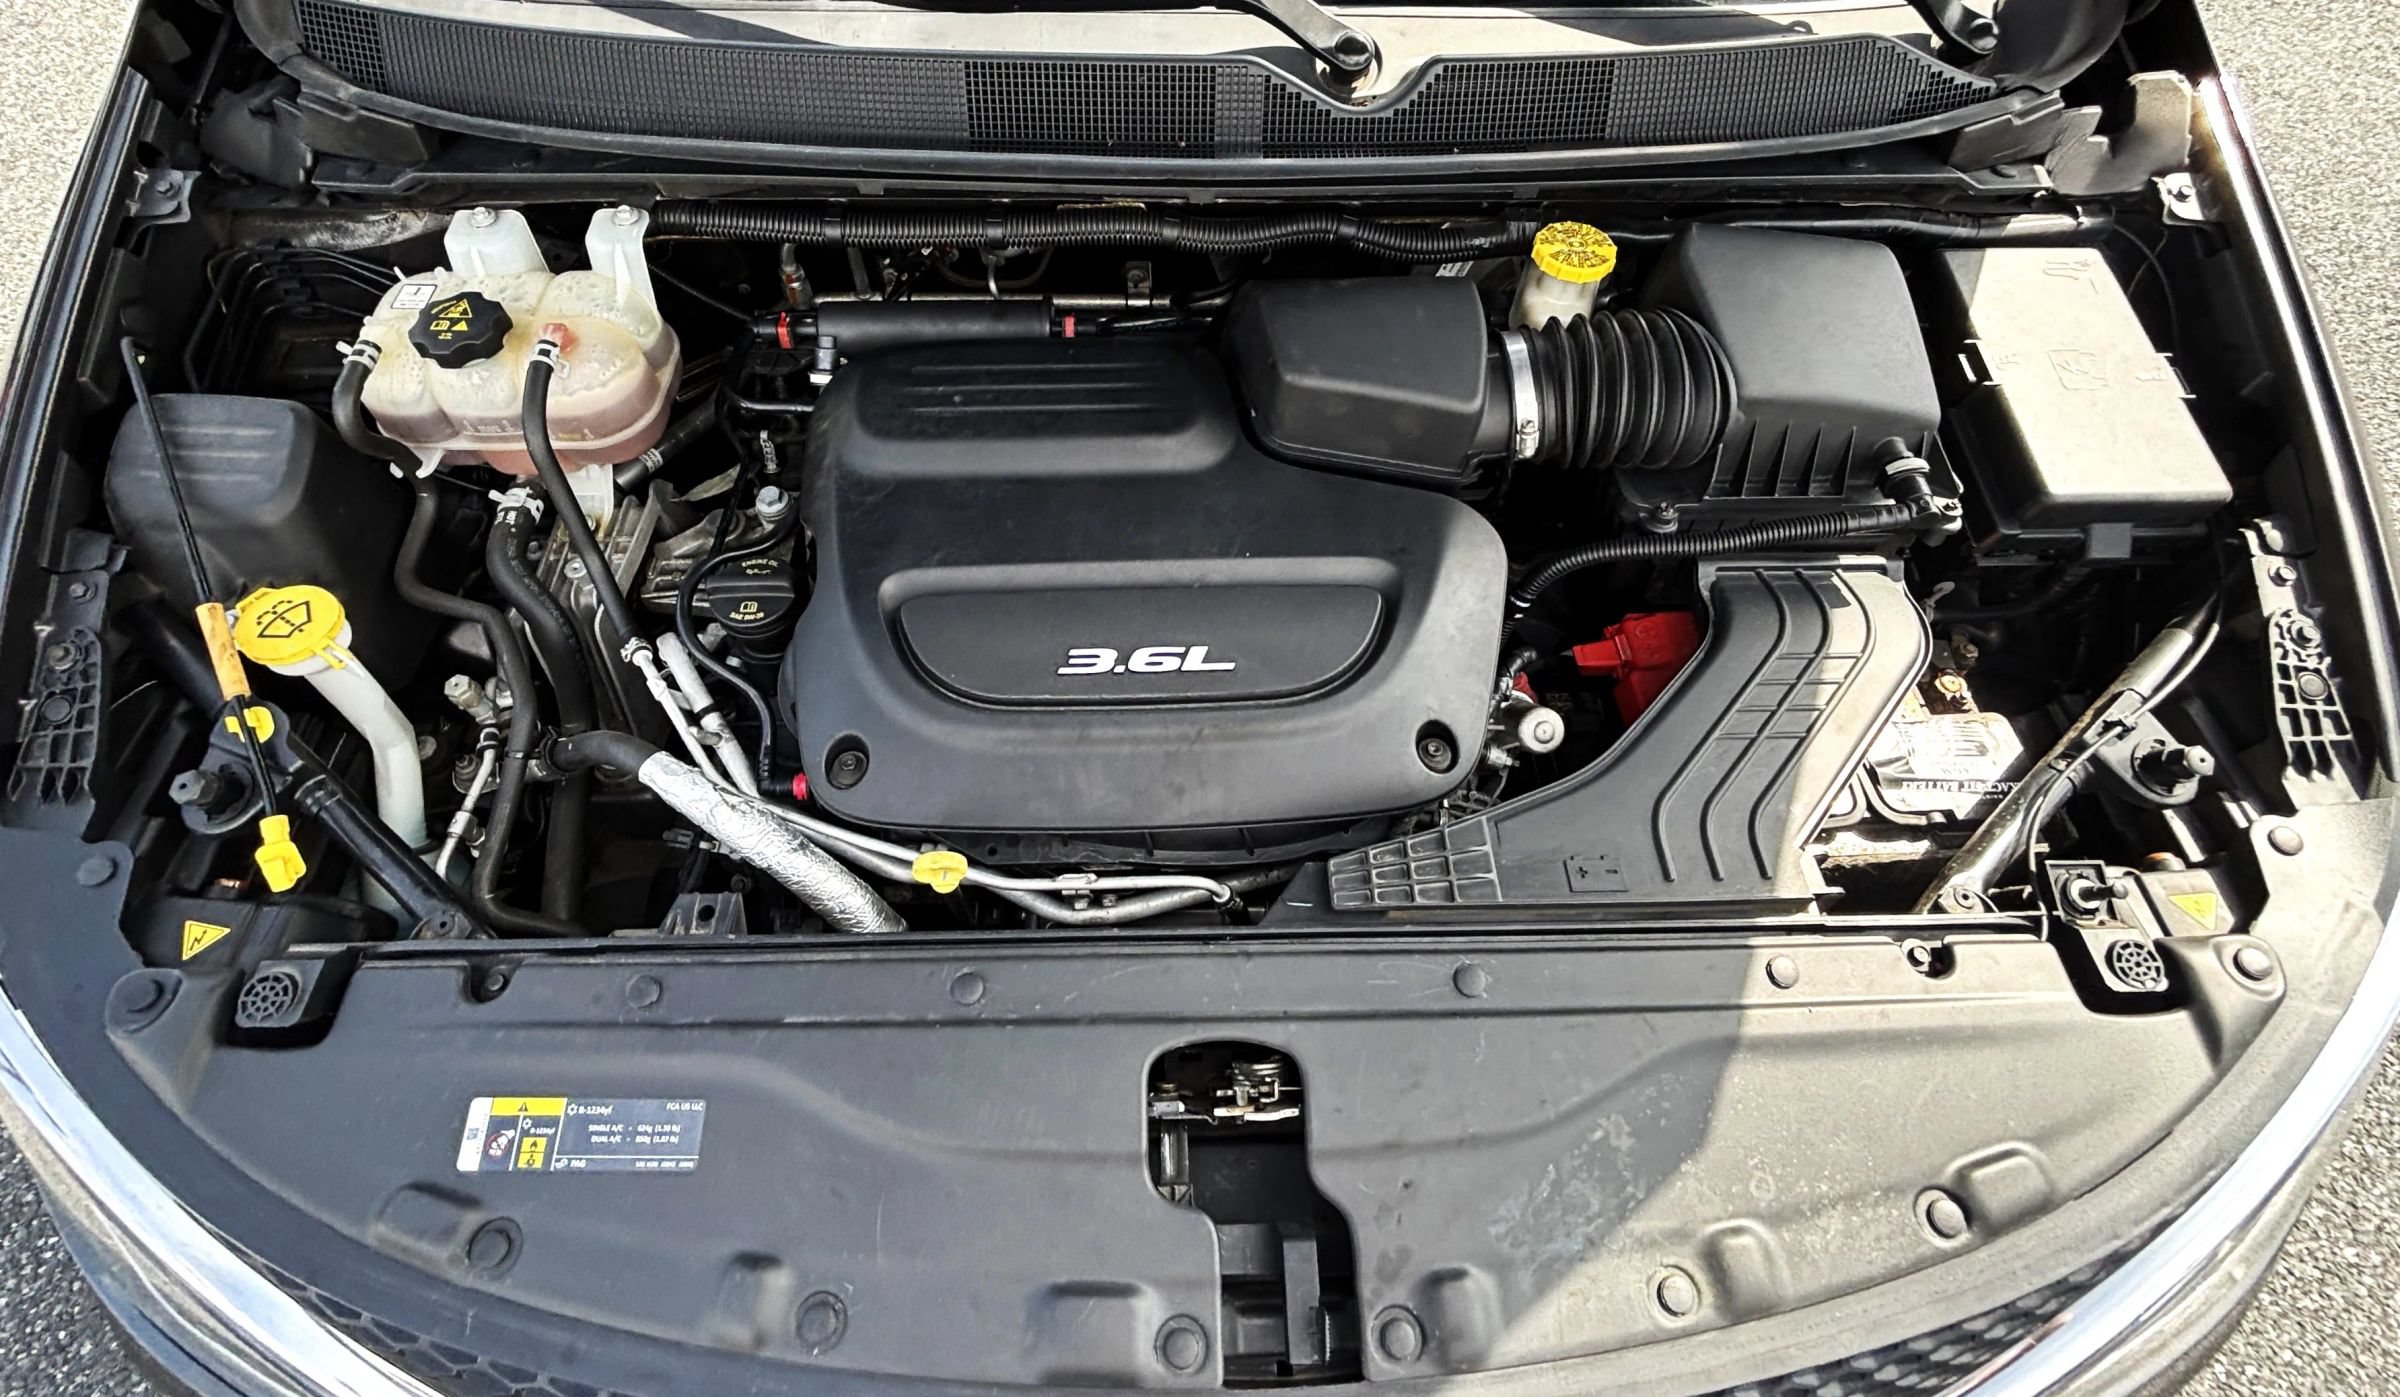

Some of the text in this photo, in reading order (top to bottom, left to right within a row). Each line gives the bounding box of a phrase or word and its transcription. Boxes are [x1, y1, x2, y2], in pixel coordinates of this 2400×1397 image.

[741, 559, 768, 567] ENGINE
[1057, 646, 1236, 675] 3.6L
[1902, 781, 1959, 792] BATTERY
[666, 1103, 680, 1111] FCA
[681, 1103, 690, 1111] US
[691, 1103, 704, 1111] LLC
[588, 1124, 610, 1132] SINGLE
[611, 1124, 624, 1133] A/C
[608, 1135, 622, 1143] A/C
[570, 1160, 586, 1168] PAG
